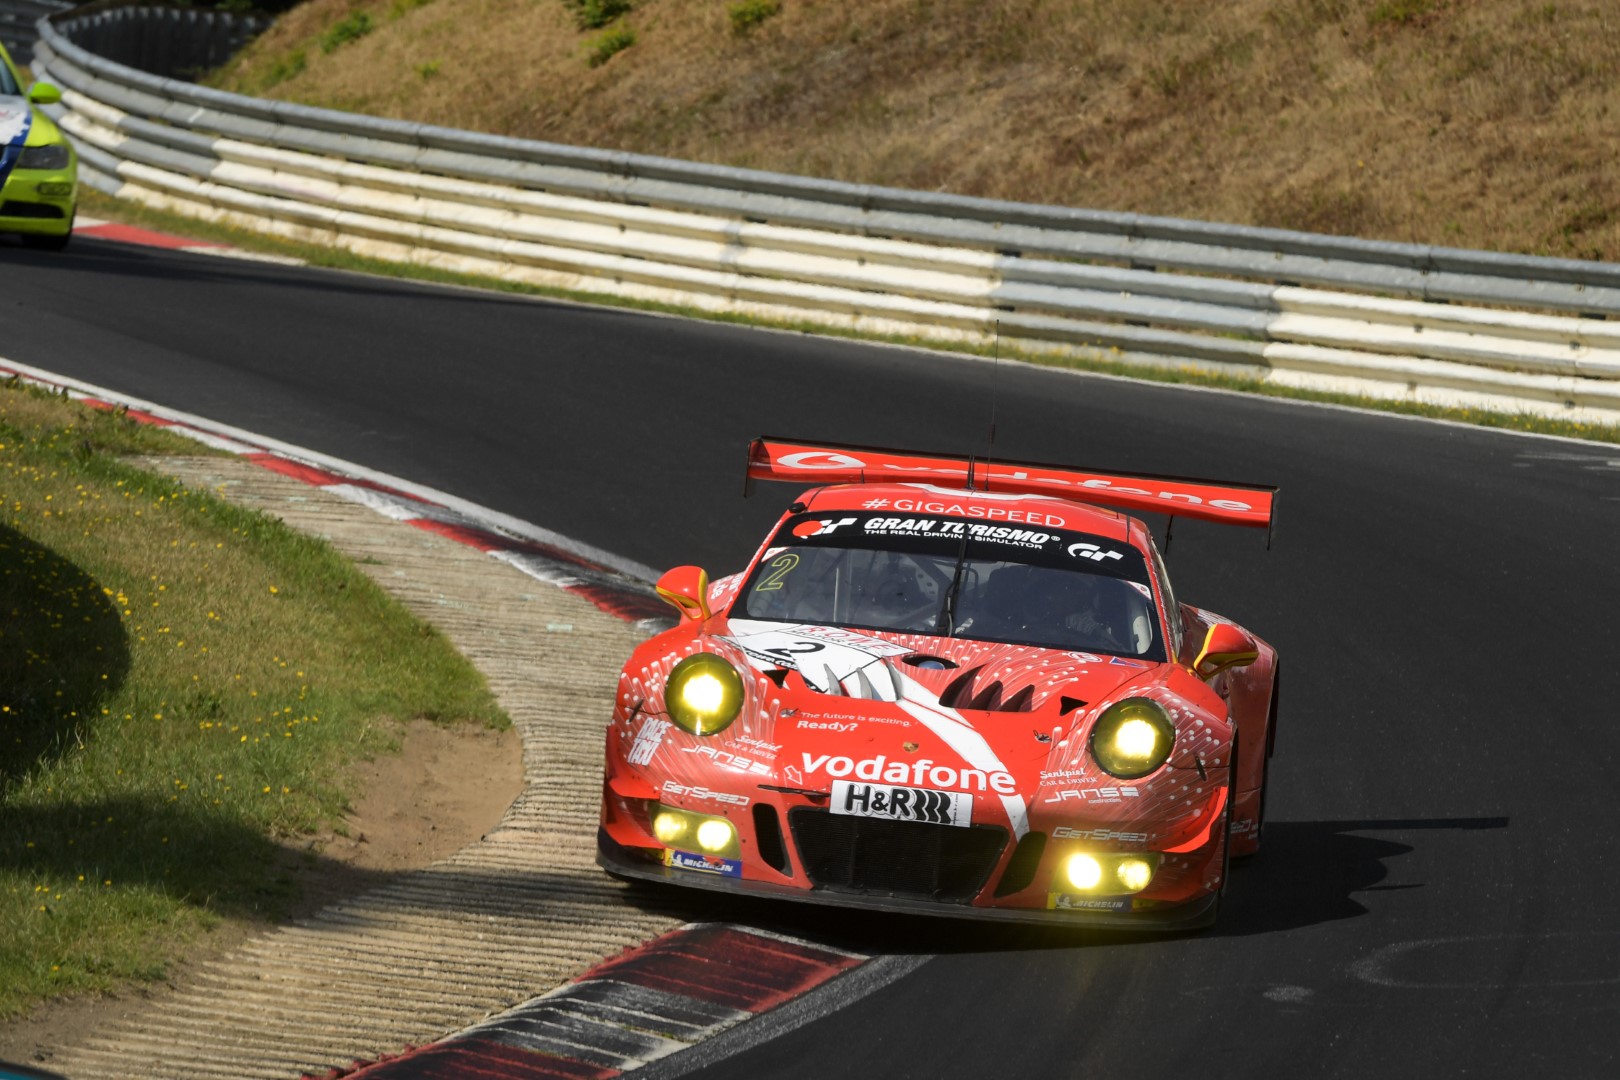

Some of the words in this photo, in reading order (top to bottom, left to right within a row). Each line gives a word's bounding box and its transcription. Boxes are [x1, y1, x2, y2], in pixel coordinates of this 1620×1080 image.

[883, 463, 1253, 511] vdfone
[862, 498, 1066, 527] #GIGASPEED
[864, 517, 937, 531] GRAN
[923, 531, 971, 540] DRIVIN
[974, 536, 1043, 550] SIMULATOR
[756, 553, 800, 592] 2
[797, 720, 859, 732] Ready?
[801, 711, 821, 719] The
[823, 712, 855, 721] future
[857, 714, 866, 722] is
[802, 752, 1016, 794] vodafone
